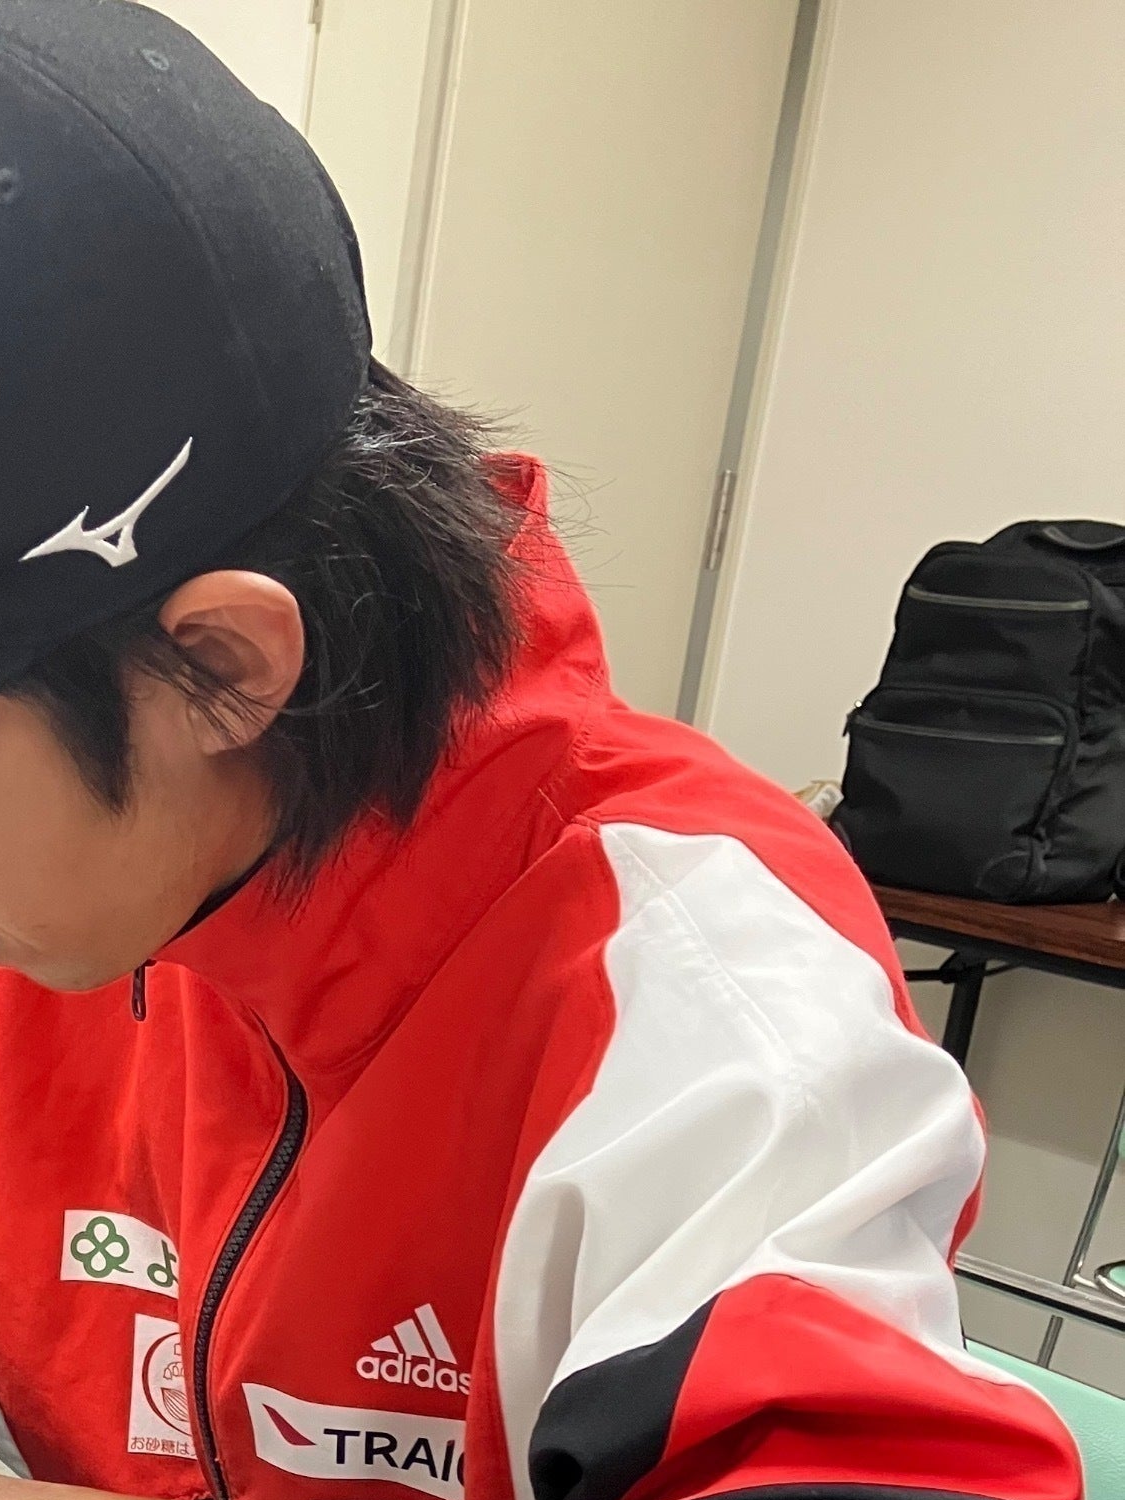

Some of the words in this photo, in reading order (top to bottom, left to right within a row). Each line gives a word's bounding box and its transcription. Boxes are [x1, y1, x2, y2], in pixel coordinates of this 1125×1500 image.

[356, 1353, 472, 1396] adidas
[130, 1436, 197, 1457] お砂糖は
[323, 1428, 466, 1488] TRAI
